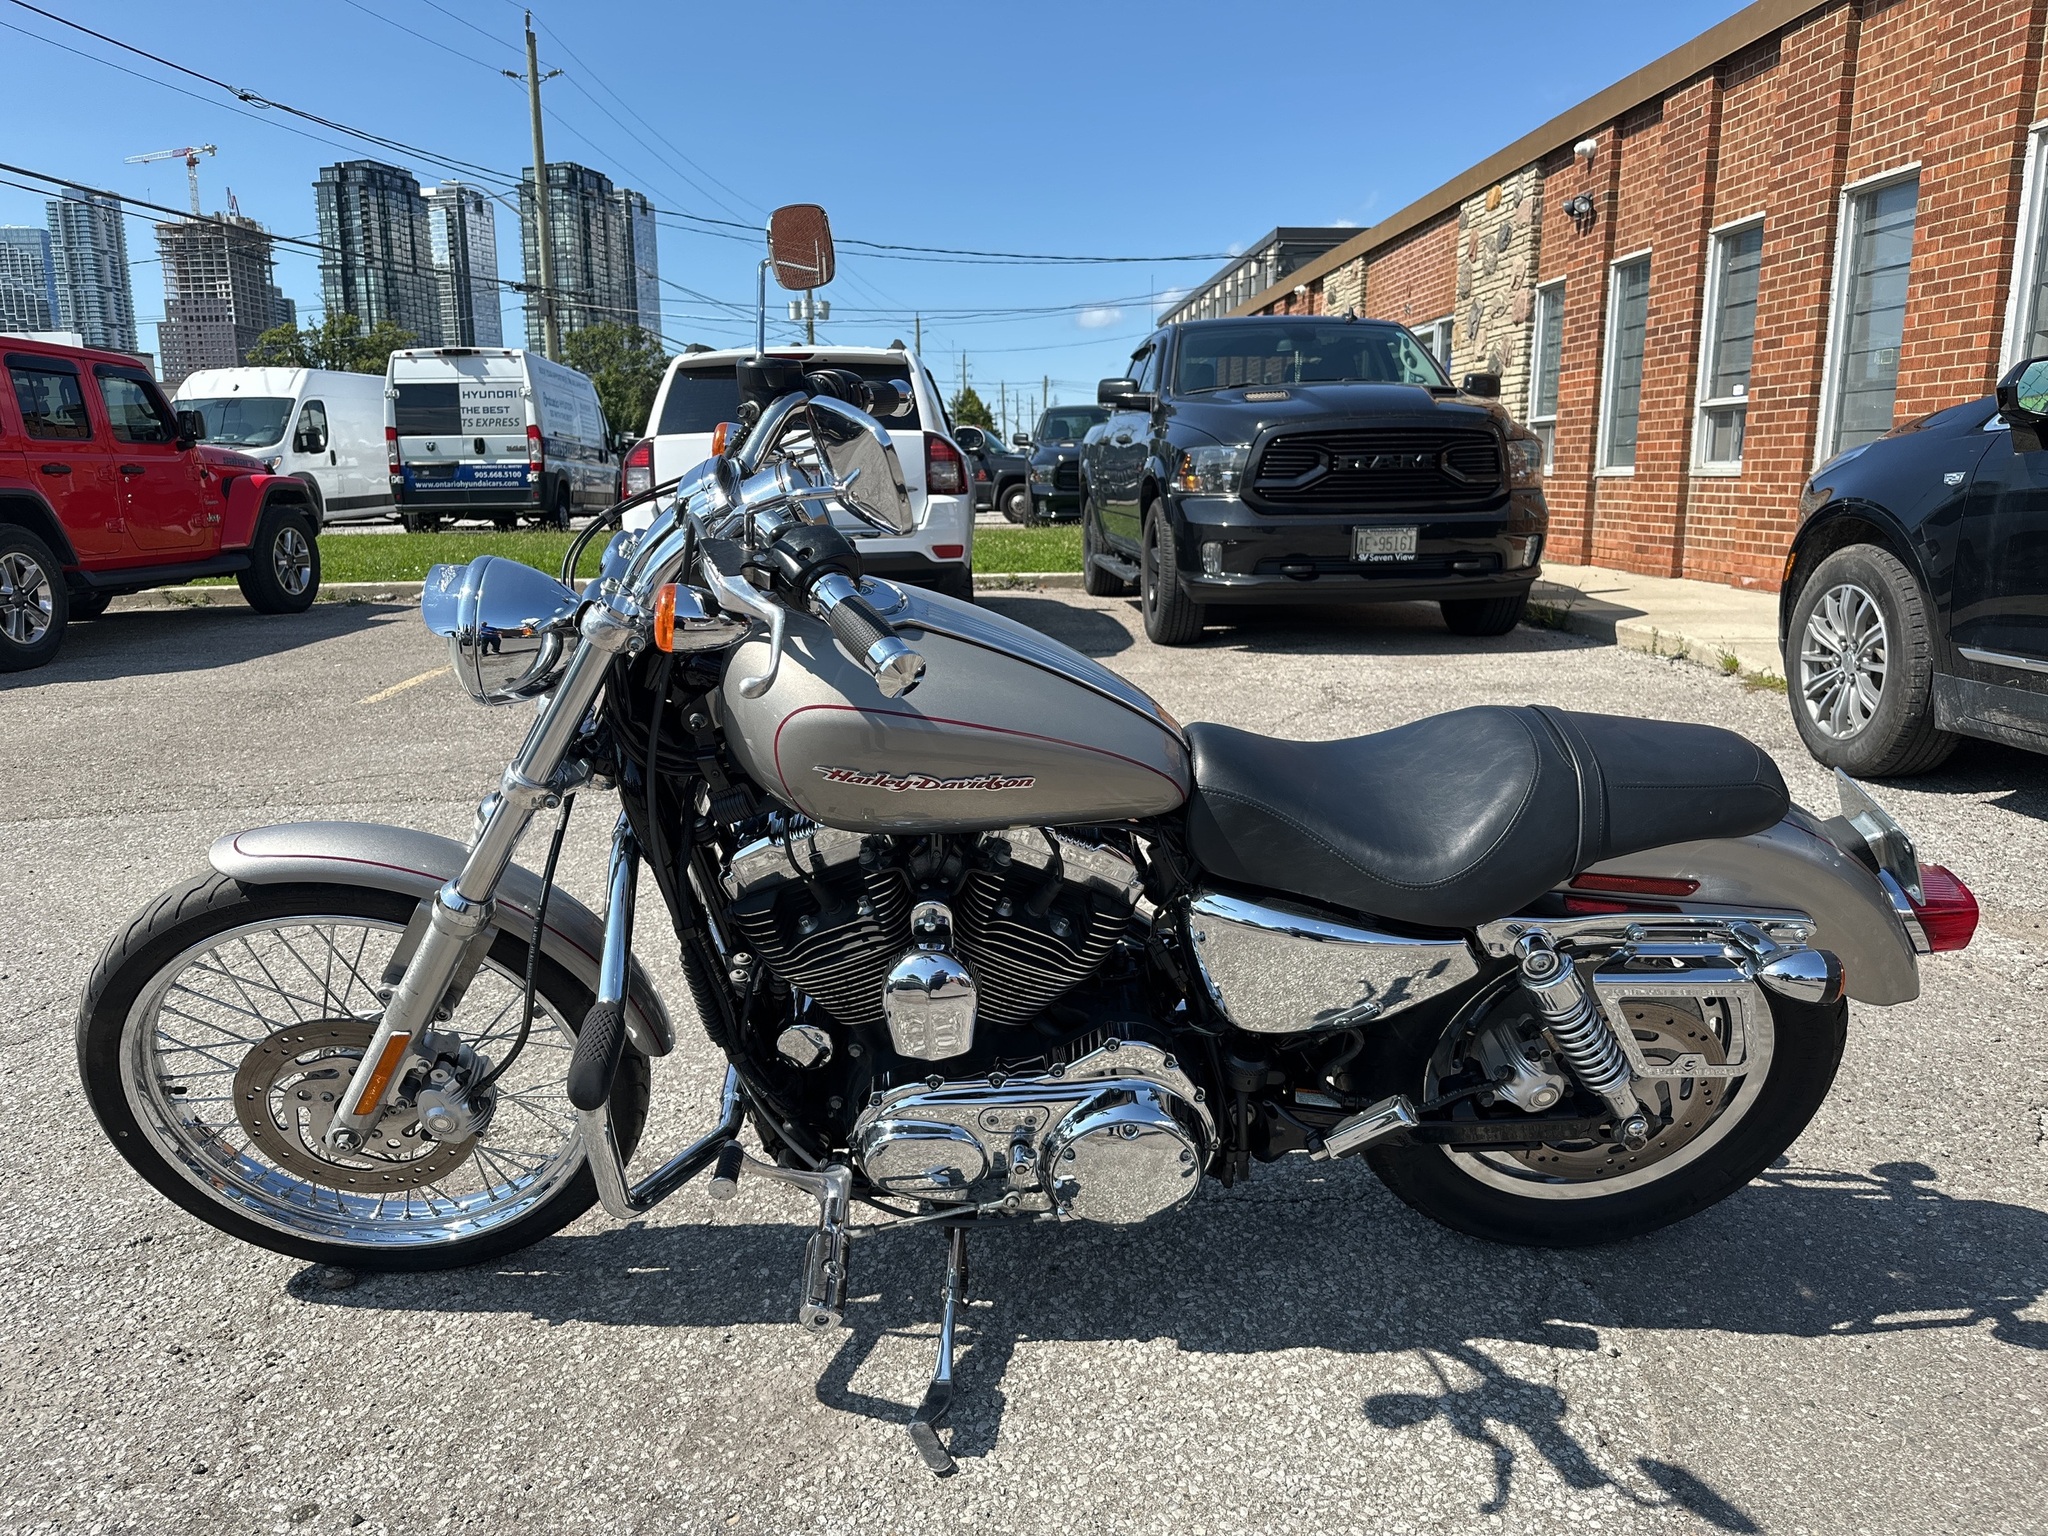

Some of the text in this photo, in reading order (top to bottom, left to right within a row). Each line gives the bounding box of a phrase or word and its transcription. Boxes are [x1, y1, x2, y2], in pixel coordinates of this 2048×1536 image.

[462, 390, 517, 399] HYUNDAI
[460, 406, 510, 414] THE BEST
[475, 417, 520, 427] EXPRESS
[1338, 454, 1433, 470] RAM
[415, 480, 519, 489] www.ontariohyundaicars.com
[1378, 536, 1413, 551] 95161
[1369, 553, 1393, 562] Seven
[1395, 553, 1415, 562] View
